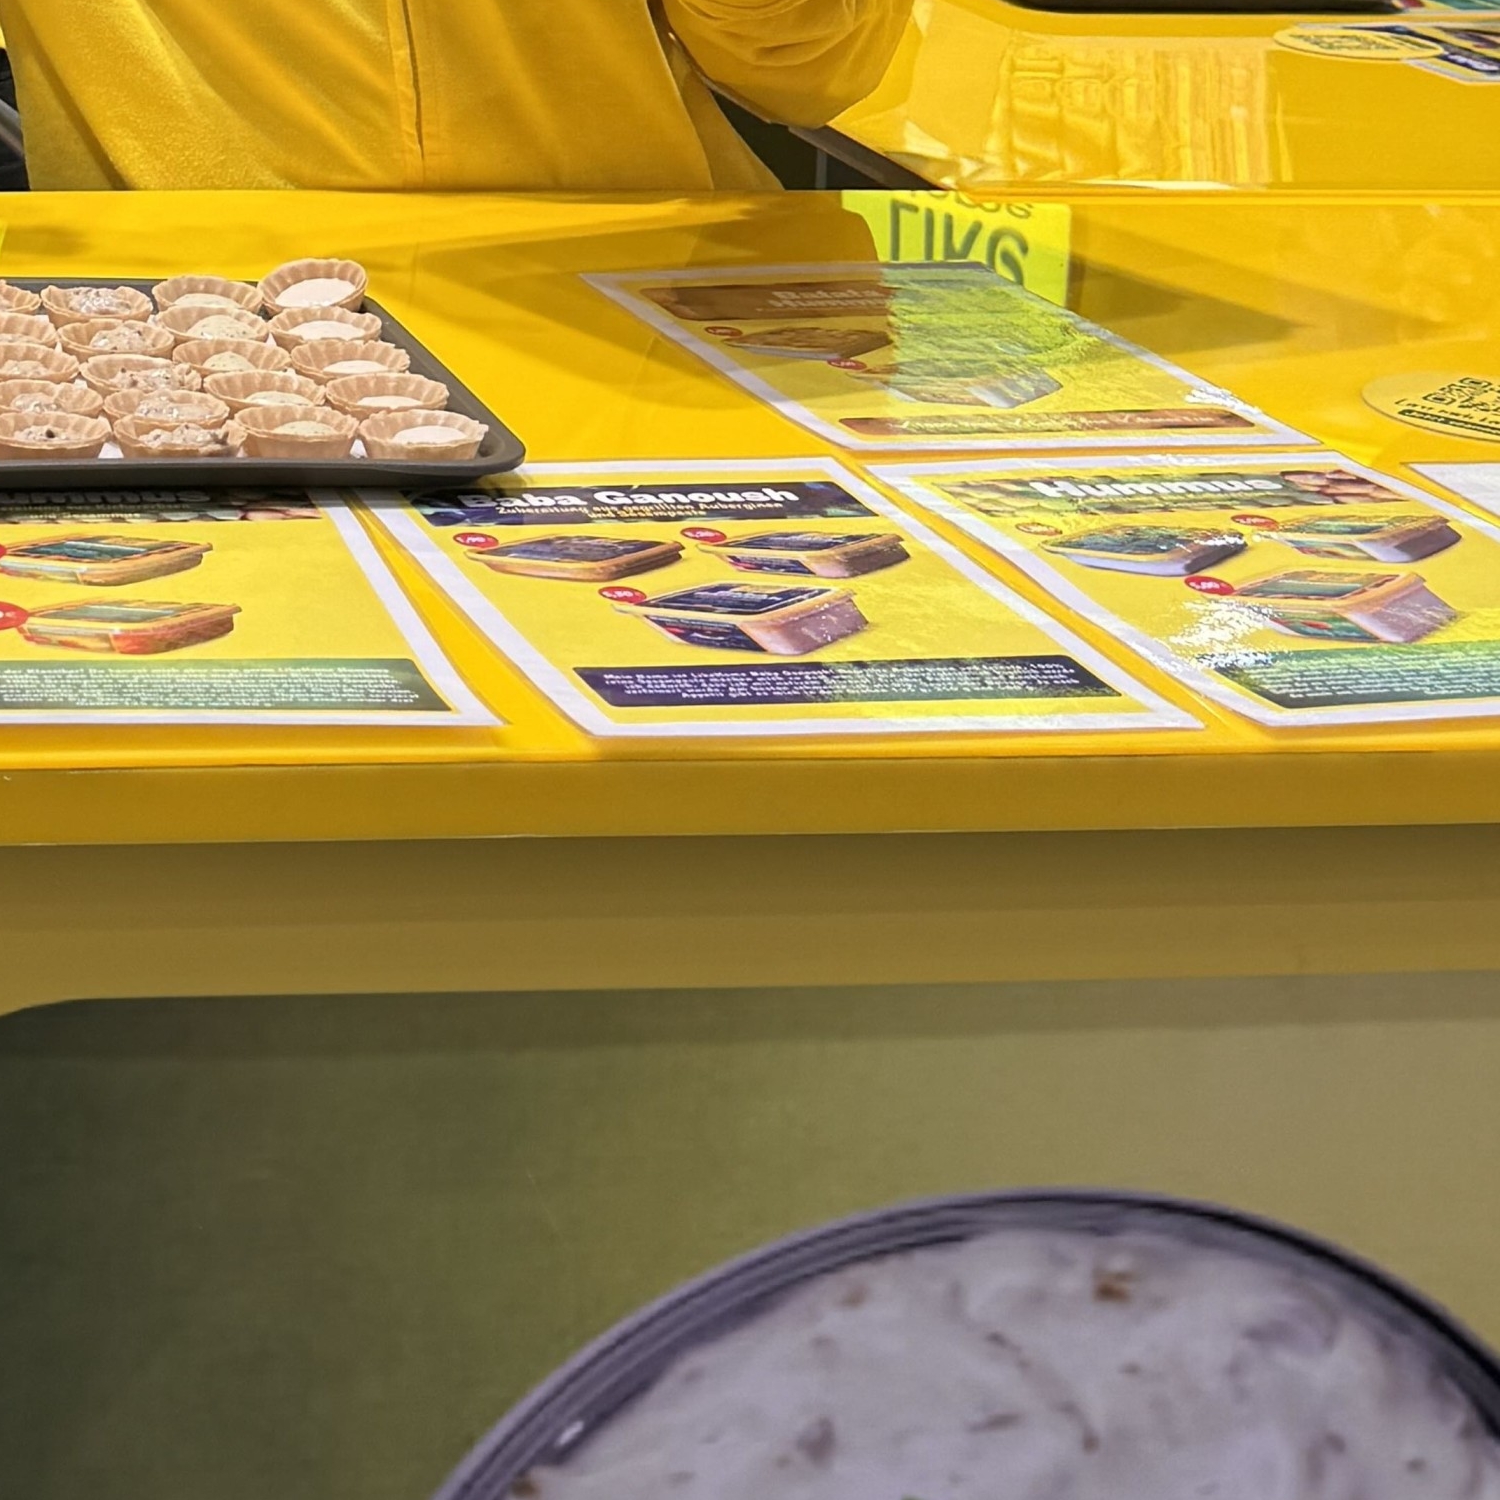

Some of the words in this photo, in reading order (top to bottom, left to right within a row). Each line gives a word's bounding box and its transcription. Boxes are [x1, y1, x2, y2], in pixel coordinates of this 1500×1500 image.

[457, 493, 587, 508] Baba
[593, 487, 800, 505] Ganoush
[1029, 479, 1283, 498] Hummus
